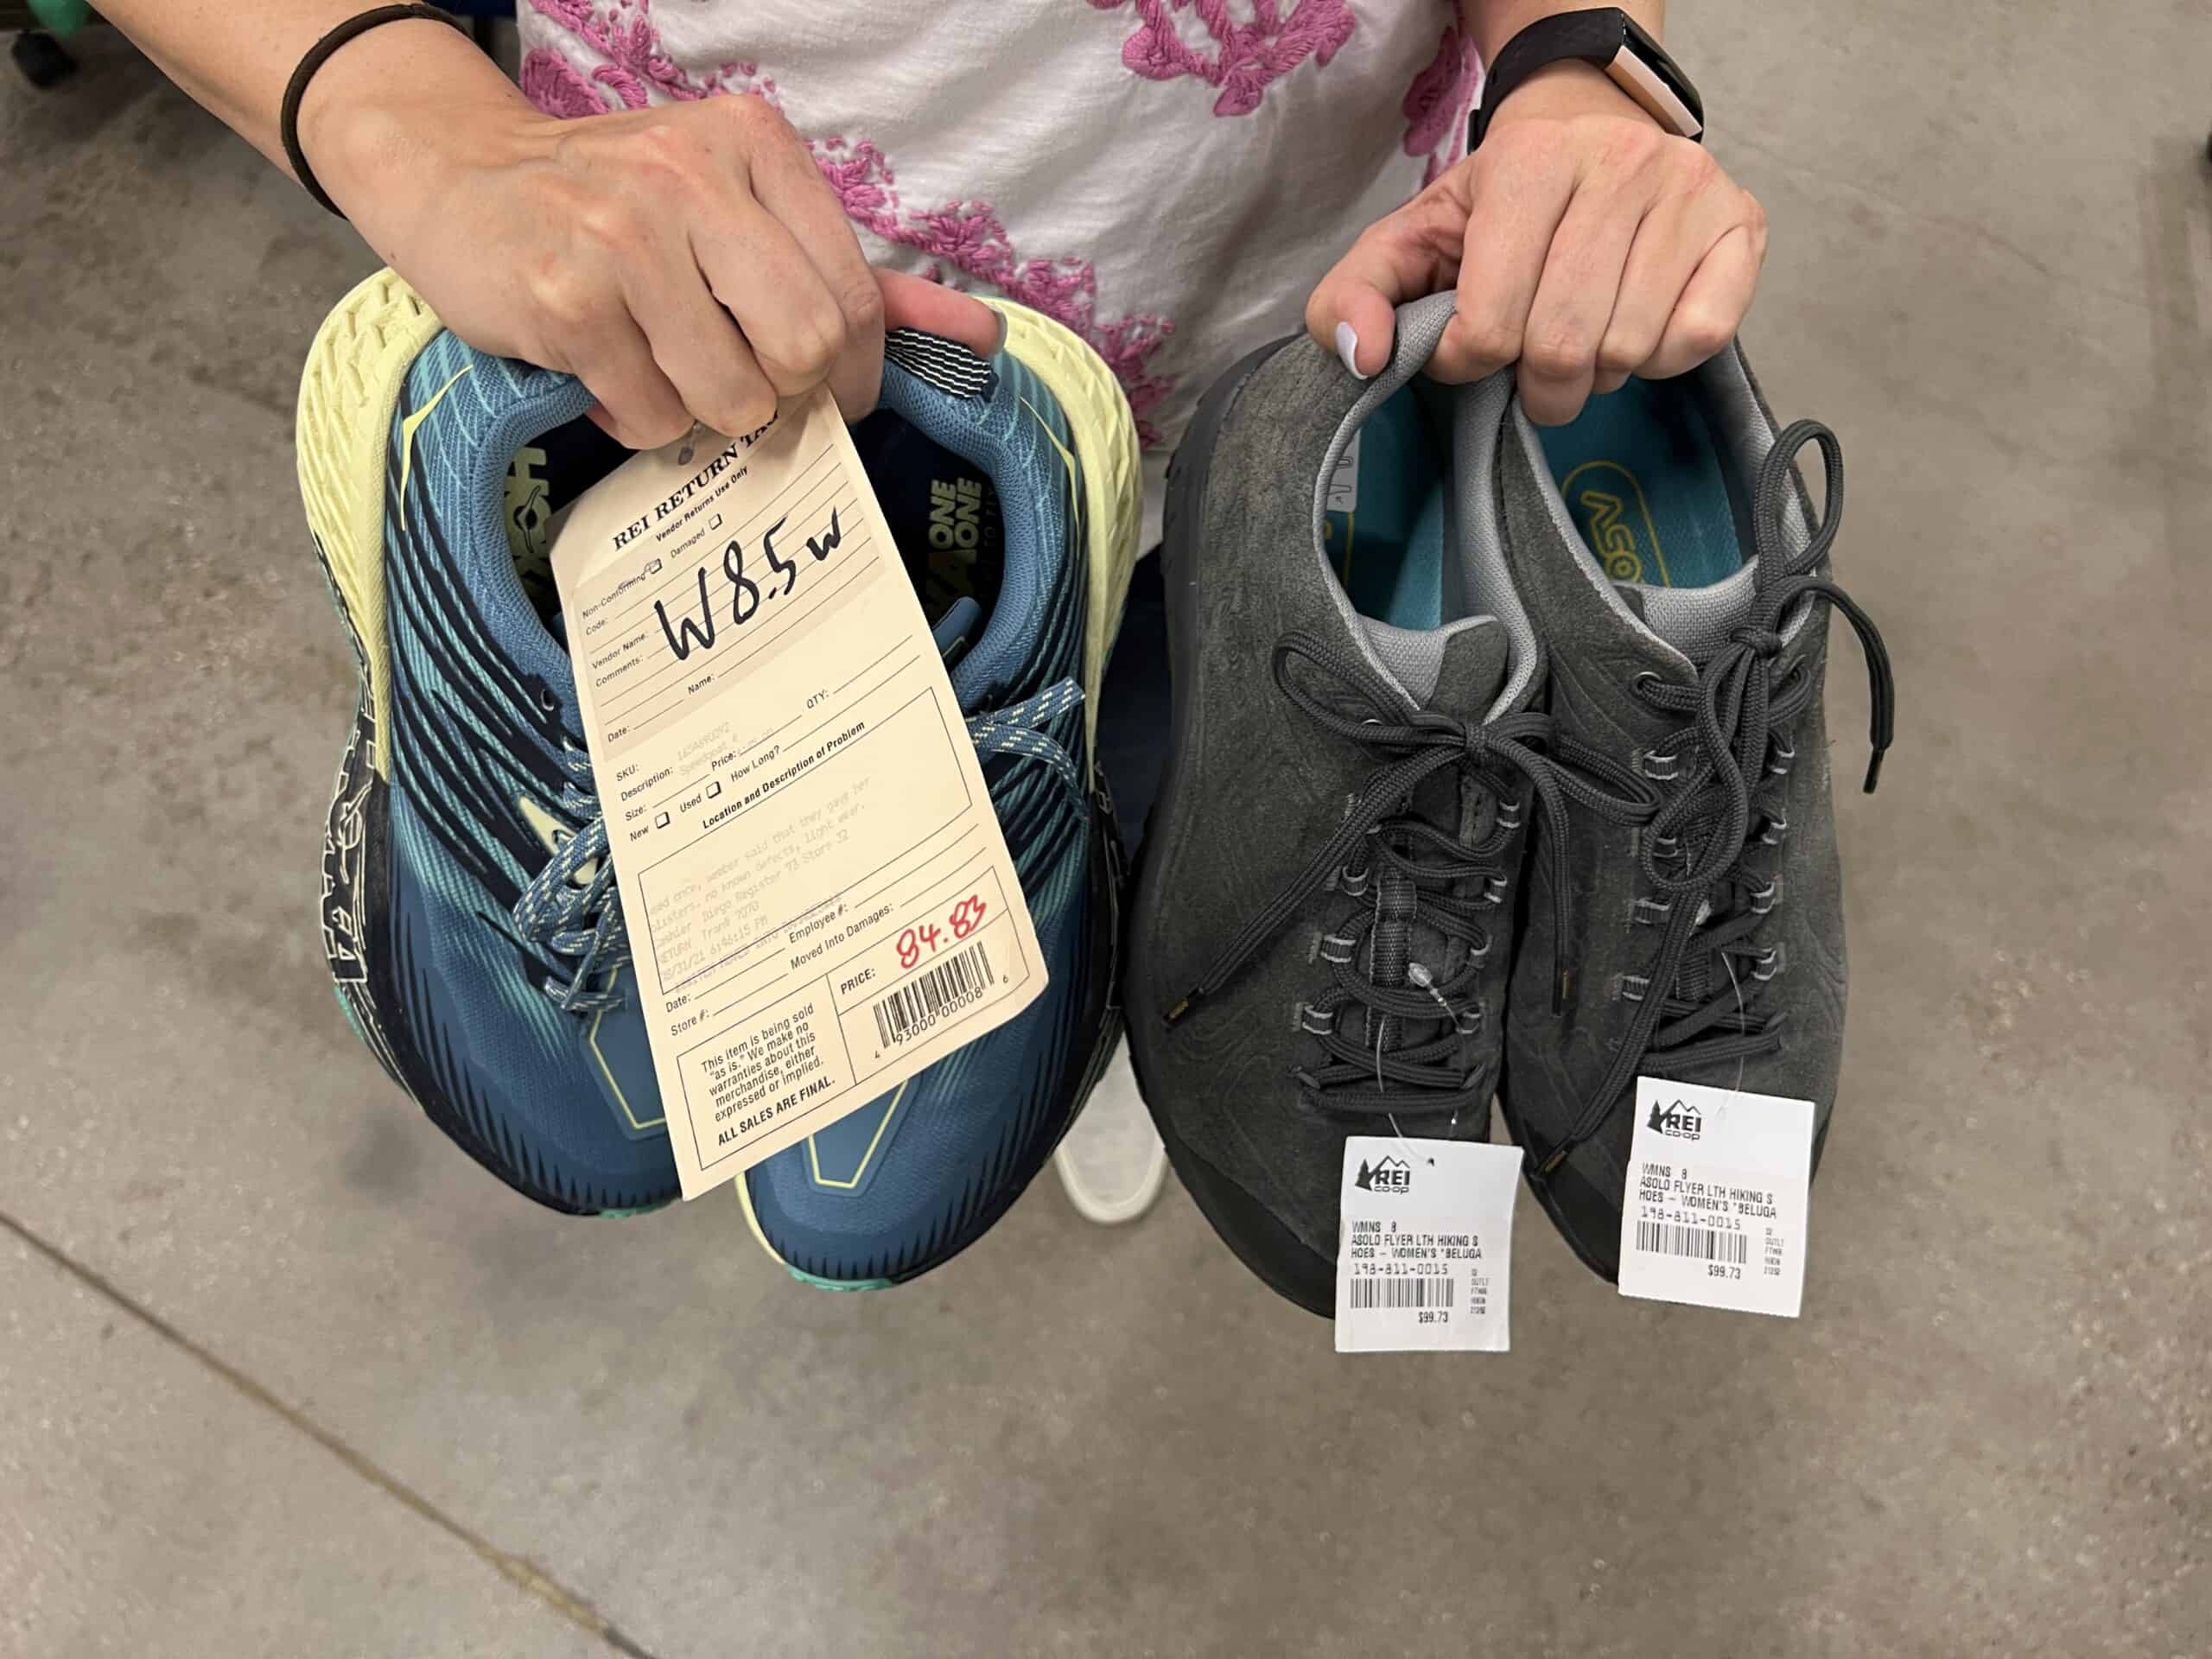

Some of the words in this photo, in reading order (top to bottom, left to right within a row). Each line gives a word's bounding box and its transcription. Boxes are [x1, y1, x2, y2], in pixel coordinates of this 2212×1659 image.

[612, 516, 651, 550] REI
[654, 442, 739, 521] RETURN
[656, 521, 683, 542] Vendor
[684, 496, 715, 522] Returns
[715, 483, 729, 498] Use
[731, 466, 747, 484] Only
[928, 478, 956, 550] ONE
[955, 477, 982, 550] ONE
[671, 528, 705, 558] Damaged
[586, 617, 609, 635] Code:
[592, 647, 621, 671] Vendor
[622, 632, 648, 652] Name:
[595, 654, 644, 688] Comments:
[607, 725, 631, 743] Date:
[688, 674, 715, 696] Name:
[616, 764, 640, 782] SKU:
[625, 804, 647, 822] Size:
[711, 750, 736, 771] Price:
[806, 690, 830, 709] QTY:
[702, 802, 743, 829] Location
[745, 787, 761, 804] and
[762, 754, 815, 792] Description
[816, 746, 826, 760] of
[826, 721, 865, 752] Problem
[620, 766, 673, 802] Description:
[630, 825, 649, 842] New
[679, 794, 702, 814] Used
[730, 766, 752, 783] How
[752, 745, 780, 771] Long?
[790, 945, 823, 970] Moved
[824, 933, 845, 952] Into
[846, 902, 893, 938] Damages:
[896, 893, 987, 969] 84.83
[665, 995, 691, 1013] Date:
[789, 911, 836, 944] Employee
[840, 967, 876, 995] PRICE:
[671, 1017, 697, 1037] Store
[896, 1014, 937, 1046] 93000
[942, 987, 983, 1019] 00008
[702, 1054, 724, 1072] This
[726, 1041, 748, 1060] item
[750, 1035, 760, 1046] is
[761, 1018, 790, 1040] being
[792, 1002, 814, 1023] sold
[747, 1046, 765, 1061] We
[766, 1030, 794, 1052] make
[796, 1021, 809, 1035] no
[709, 1061, 762, 1096] warranties
[765, 1044, 794, 1067] about
[796, 1032, 816, 1049] this
[715, 1066, 784, 1108] merchandise,
[785, 1045, 815, 1070] either
[715, 1087, 766, 1122] expressed
[769, 1081, 780, 1093] or
[781, 1055, 823, 1085] implied.
[718, 1127, 738, 1146] ALL
[740, 1107, 773, 1134] SALES
[776, 1094, 798, 1113] ARE
[800, 1076, 836, 1101] FINAL.
[1666, 1113, 1701, 1133] REI
[1375, 1169, 1410, 1185] REI
[1640, 1176, 1670, 1191] ASOLO
[1674, 1180, 1704, 1195] FLYER
[1707, 1185, 1726, 1198] LTH
[1729, 1188, 1764, 1204] HIKING
[1766, 1192, 1773, 1205] S
[1643, 1163, 1671, 1178] WMNS
[1681, 1168, 1688, 1180] 8
[1639, 1189, 1663, 1202] HOES
[1681, 1194, 1728, 1211] WOMEN'S
[1351, 1221, 1381, 1233] WMNS
[1391, 1221, 1397, 1233] 8
[1351, 1234, 1381, 1246] ASOLO
[1384, 1235, 1413, 1246] FLYER
[1416, 1235, 1433, 1246] LTH
[1438, 1235, 1469, 1247] HIKING
[1472, 1236, 1478, 1247] S
[1351, 1248, 1375, 1258] HOES
[1392, 1248, 1437, 1259] WOMEN'S
[1707, 1264, 1741, 1280] $99.73
[1418, 1311, 1449, 1324] $99.73
